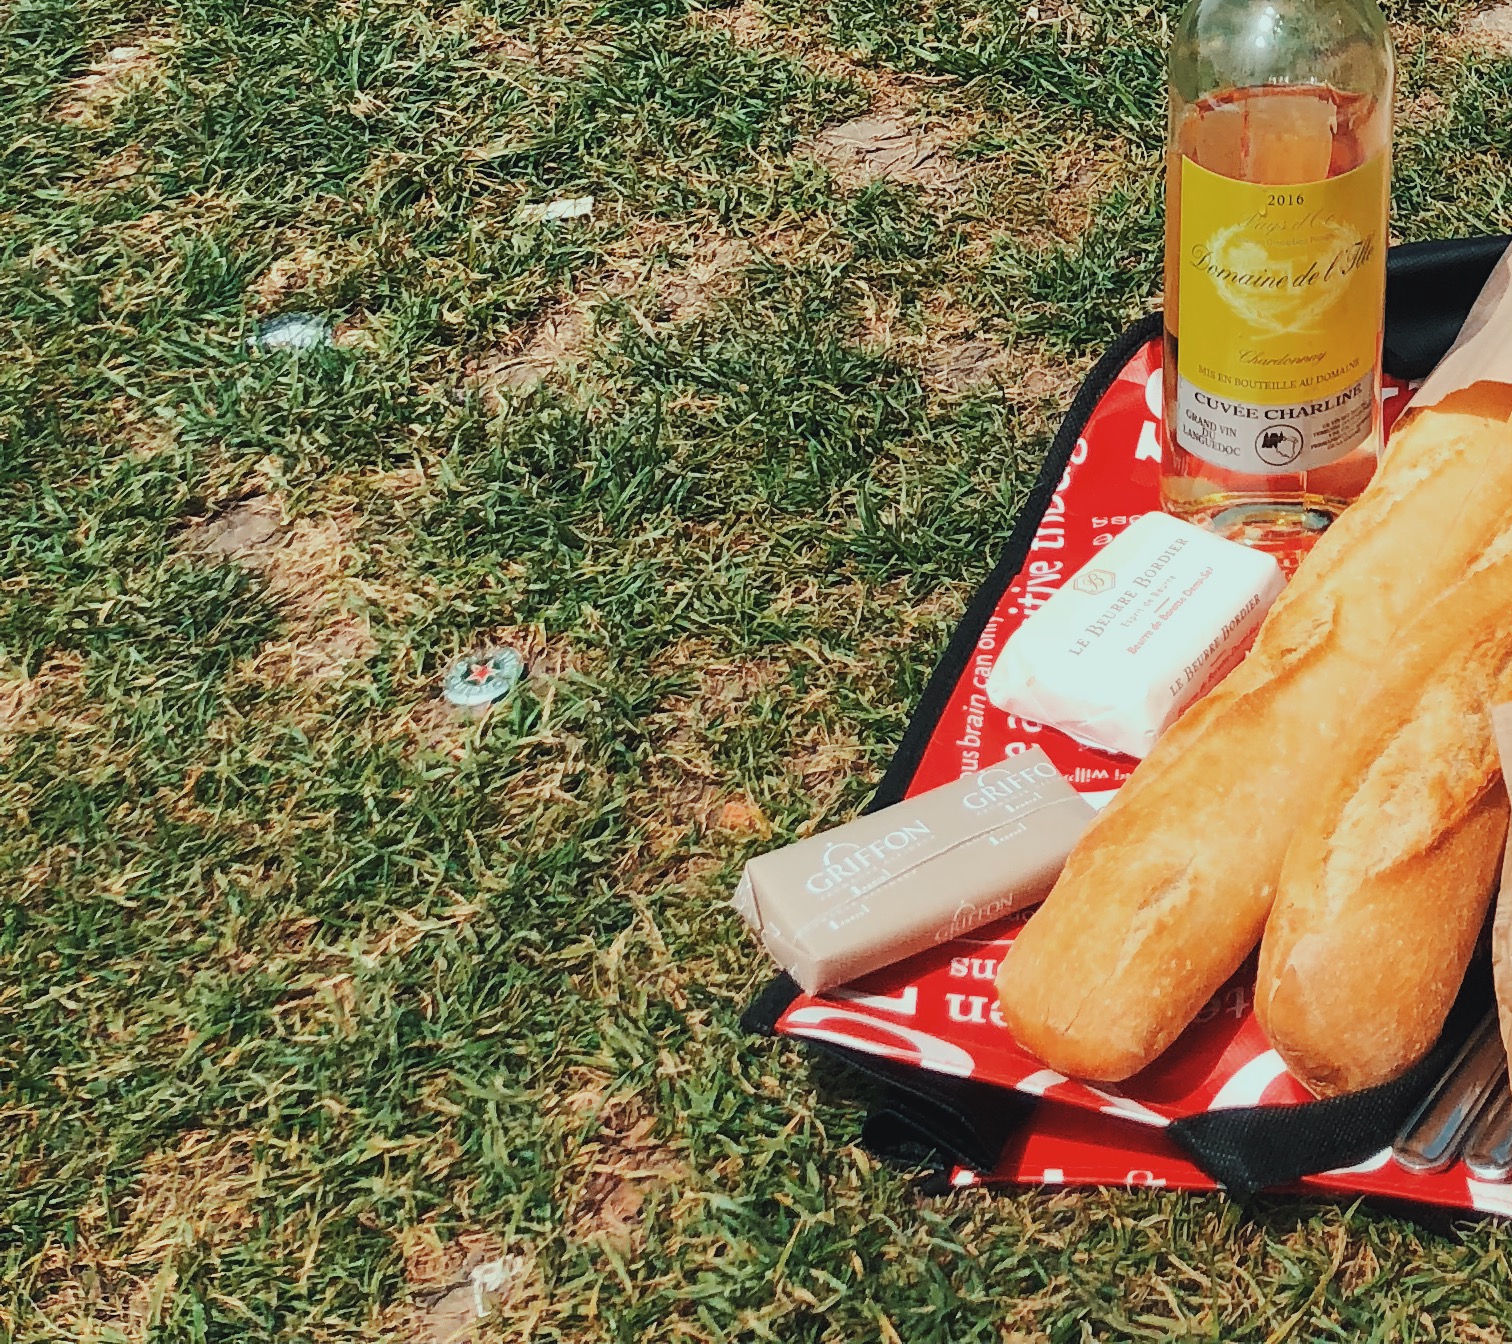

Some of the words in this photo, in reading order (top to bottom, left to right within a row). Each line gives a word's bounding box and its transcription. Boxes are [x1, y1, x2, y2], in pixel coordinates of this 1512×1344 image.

[1267, 193, 1304, 206] 2016
[1190, 243, 1288, 289] Domaine
[1292, 262, 1319, 288] de
[1198, 364, 1216, 381] MIS
[1218, 373, 1232, 385] EN
[1234, 378, 1297, 390] BOUTEILLE
[1299, 376, 1313, 388] AU
[1316, 357, 1360, 384] DOMAINE
[1238, 349, 1327, 367] Chardonnay
[1194, 391, 1259, 419] CUVÉE
[1263, 382, 1362, 420] CHARLINE
[1183, 424, 1241, 457] LANGUEDOC
[1185, 408, 1217, 432] GRAND
[1219, 423, 1237, 438] VIN
[1202, 426, 1216, 440] DU
[1068, 638, 1091, 656] LE
[1085, 589, 1138, 638] BEURRE
[1132, 537, 1190, 589] BORDIER
[1169, 678, 1185, 697] LE
[1183, 638, 1223, 682] BEURRE
[1220, 593, 1261, 642] BORDIER
[956, 694, 987, 748] brain
[972, 654, 994, 689] can
[963, 761, 1057, 810] GRIFFO
[805, 819, 932, 895] GRIFFON
